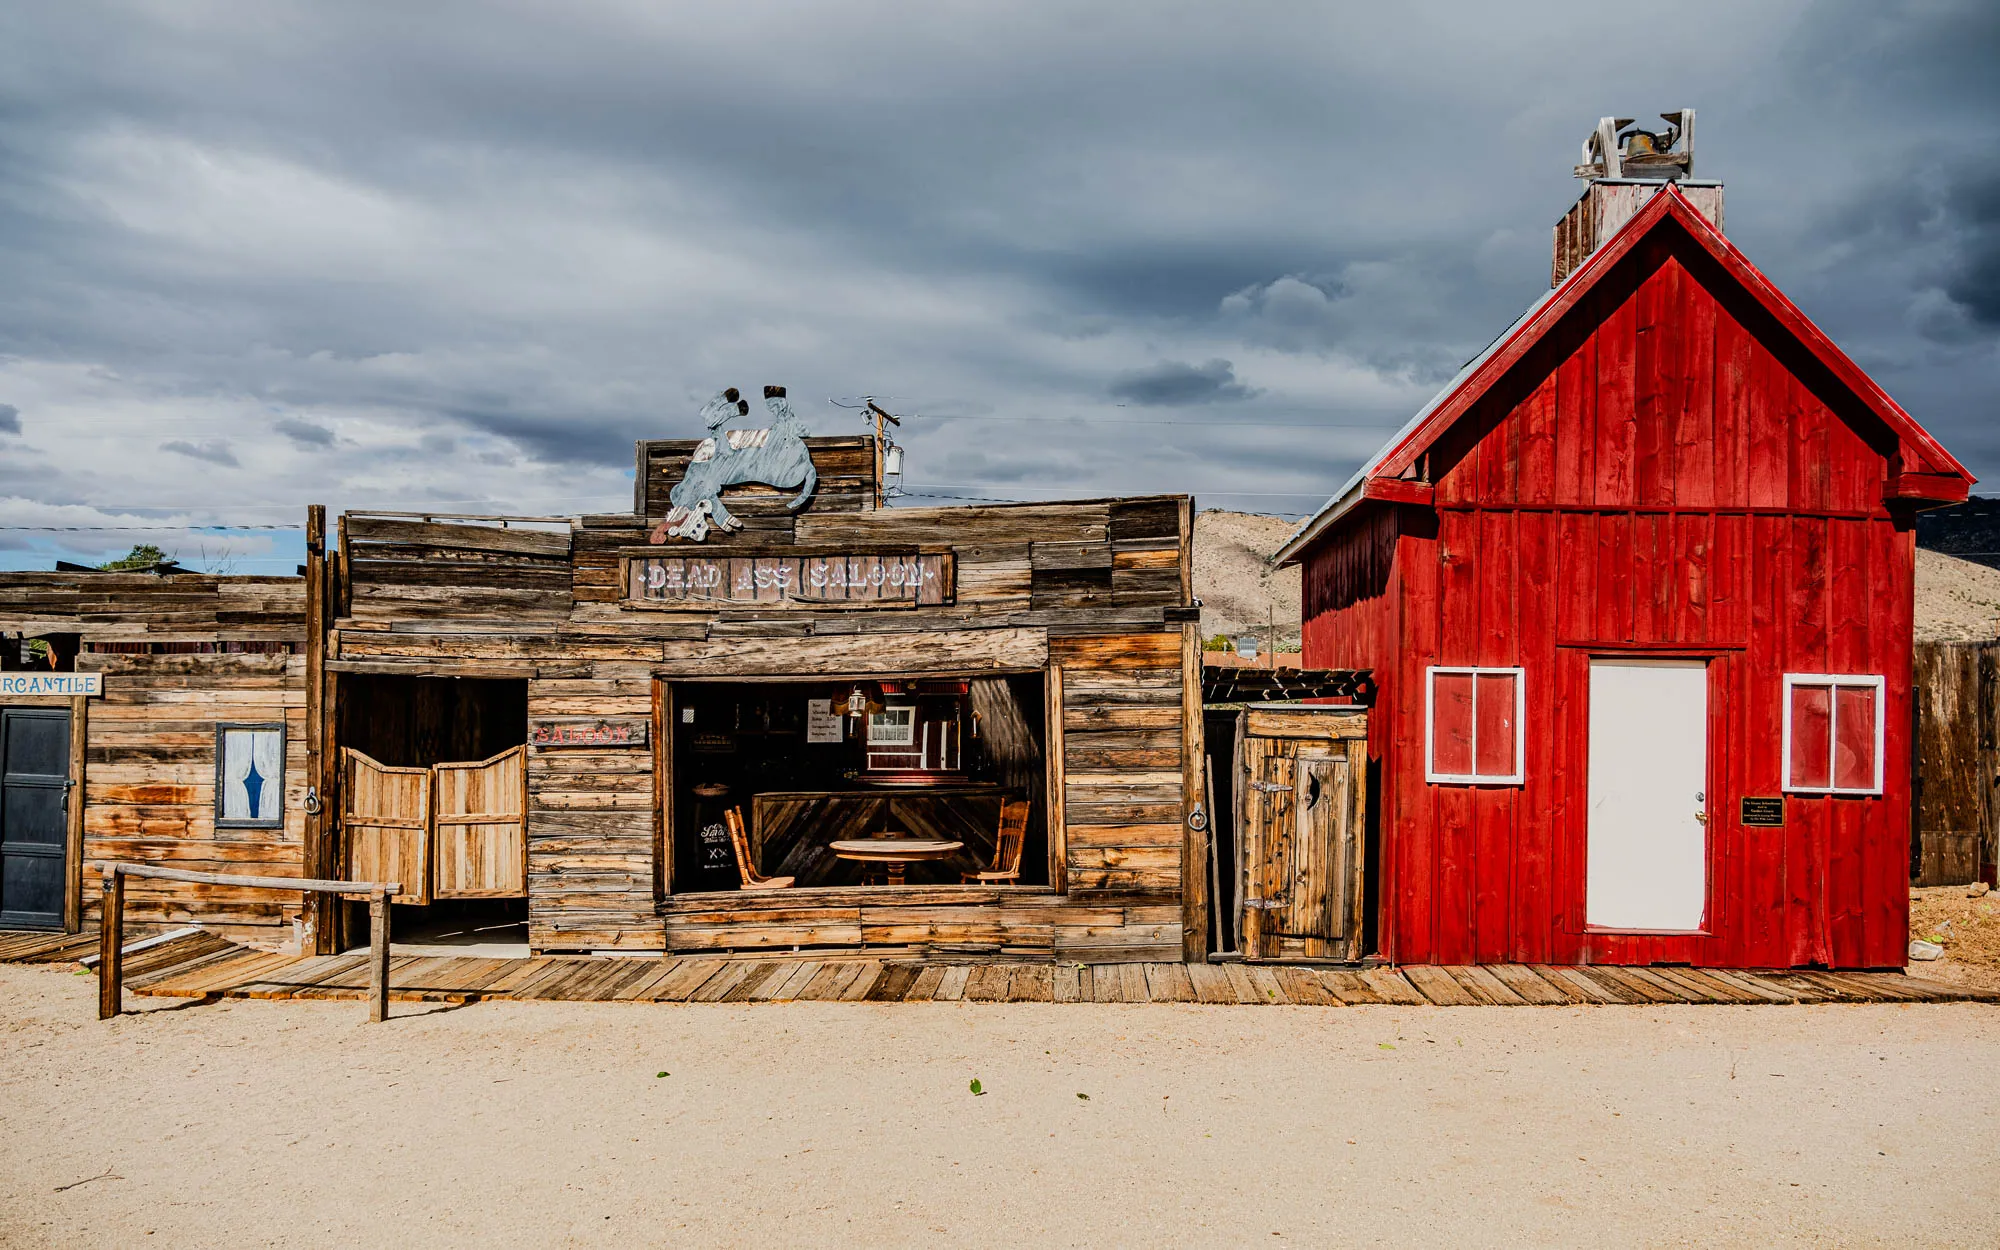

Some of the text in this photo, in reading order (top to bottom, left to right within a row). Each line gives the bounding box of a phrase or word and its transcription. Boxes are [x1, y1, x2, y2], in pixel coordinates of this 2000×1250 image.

[648, 562, 924, 590] DEAD ASS SALOON
[535, 726, 630, 744] SALOON
